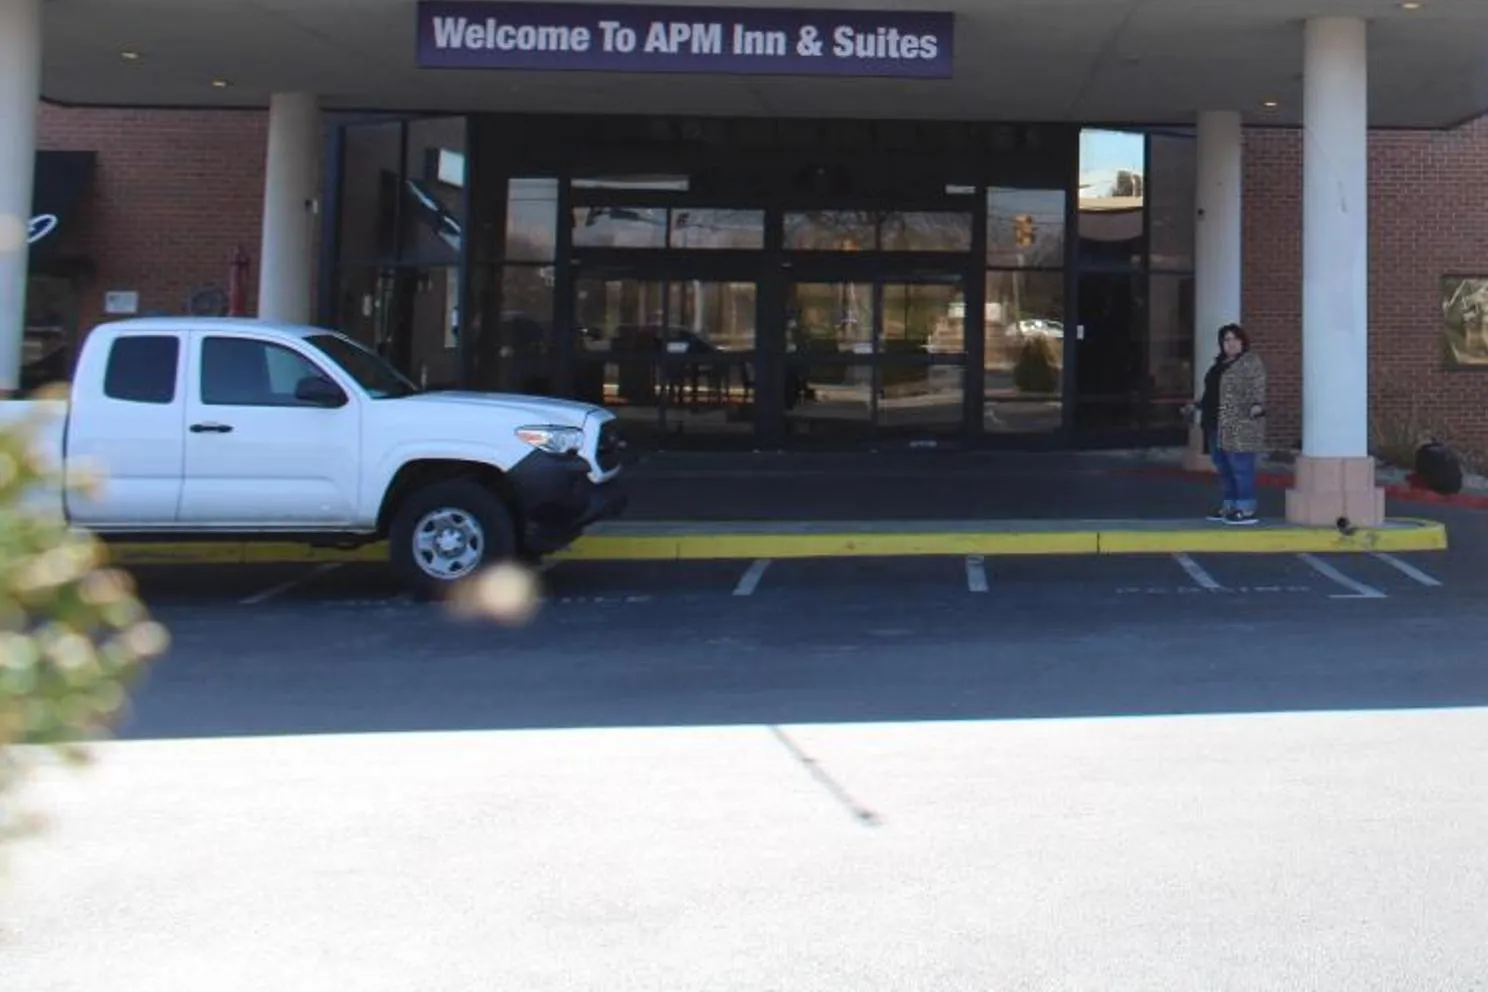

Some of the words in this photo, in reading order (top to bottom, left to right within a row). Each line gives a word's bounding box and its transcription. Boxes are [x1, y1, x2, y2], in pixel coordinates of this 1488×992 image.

[433, 17, 590, 52] Welcome
[599, 21, 636, 53] To
[644, 22, 721, 54] APM
[733, 24, 786, 56] Inn
[796, 25, 823, 57] &
[833, 26, 937, 59] Suites
